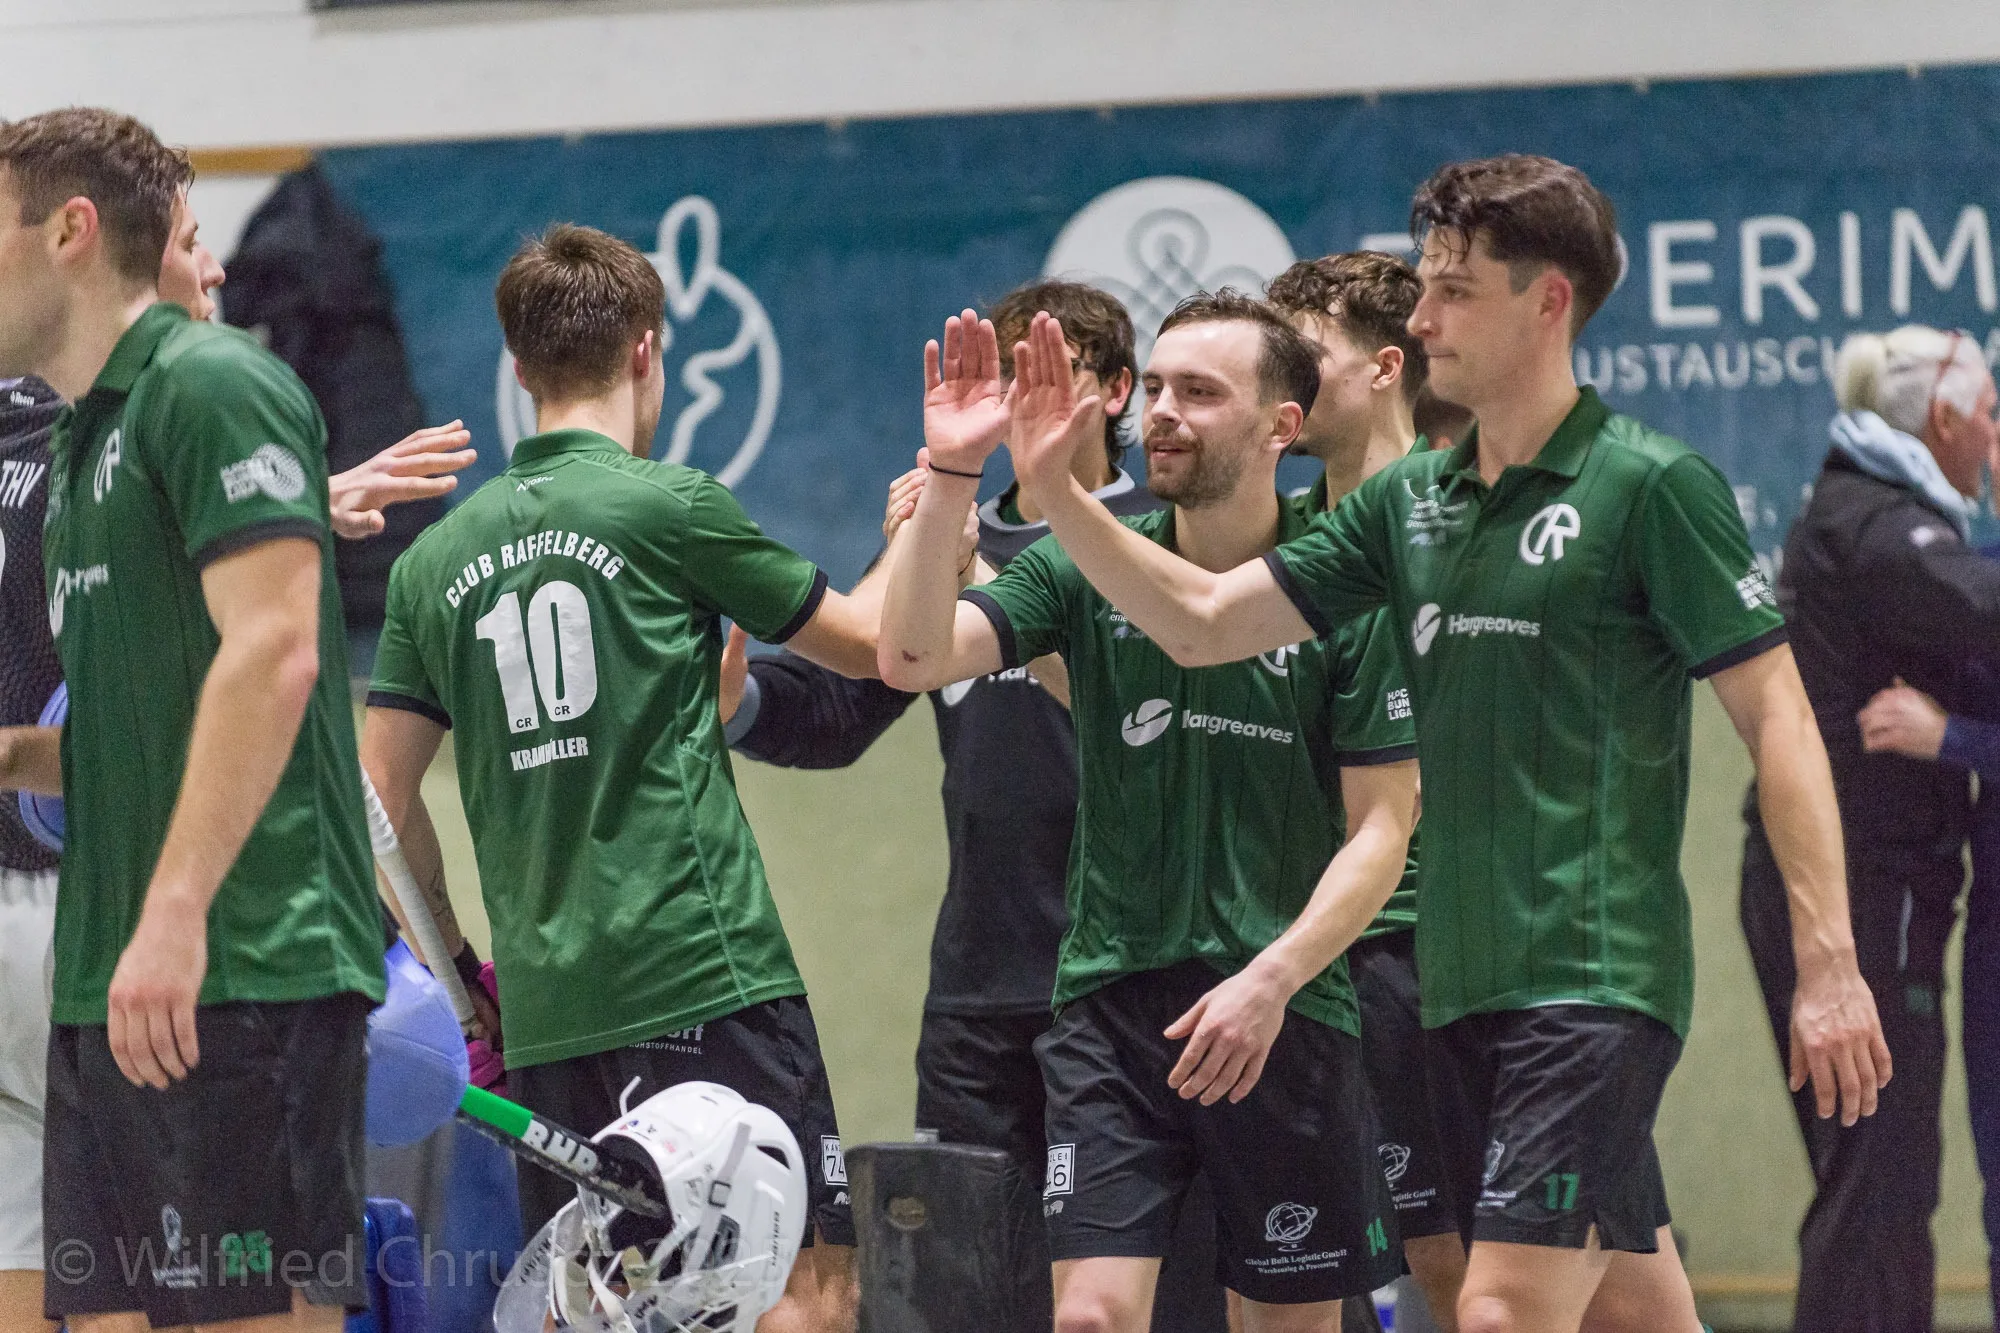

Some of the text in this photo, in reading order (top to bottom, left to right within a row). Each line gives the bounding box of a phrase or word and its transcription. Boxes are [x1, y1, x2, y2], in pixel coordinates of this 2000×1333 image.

[1617, 204, 1998, 328] ERIM
[445, 530, 625, 608] CLUB RAFFELBERG
[1449, 613, 1541, 637] Hargreaves
[475, 580, 598, 734] 10
[555, 705, 571, 716] CR
[1388, 698, 1410, 710] BUN
[1389, 708, 1413, 720] LIGA
[516, 717, 532, 729] CR
[1542, 1173, 1580, 1210] 17
[1366, 1217, 1388, 1256] 14
[1245, 1249, 1347, 1266] Global Bulk Logistic GmbH
[1258, 1265, 1297, 1274] Warehousing
[1306, 1261, 1339, 1271] Processing
